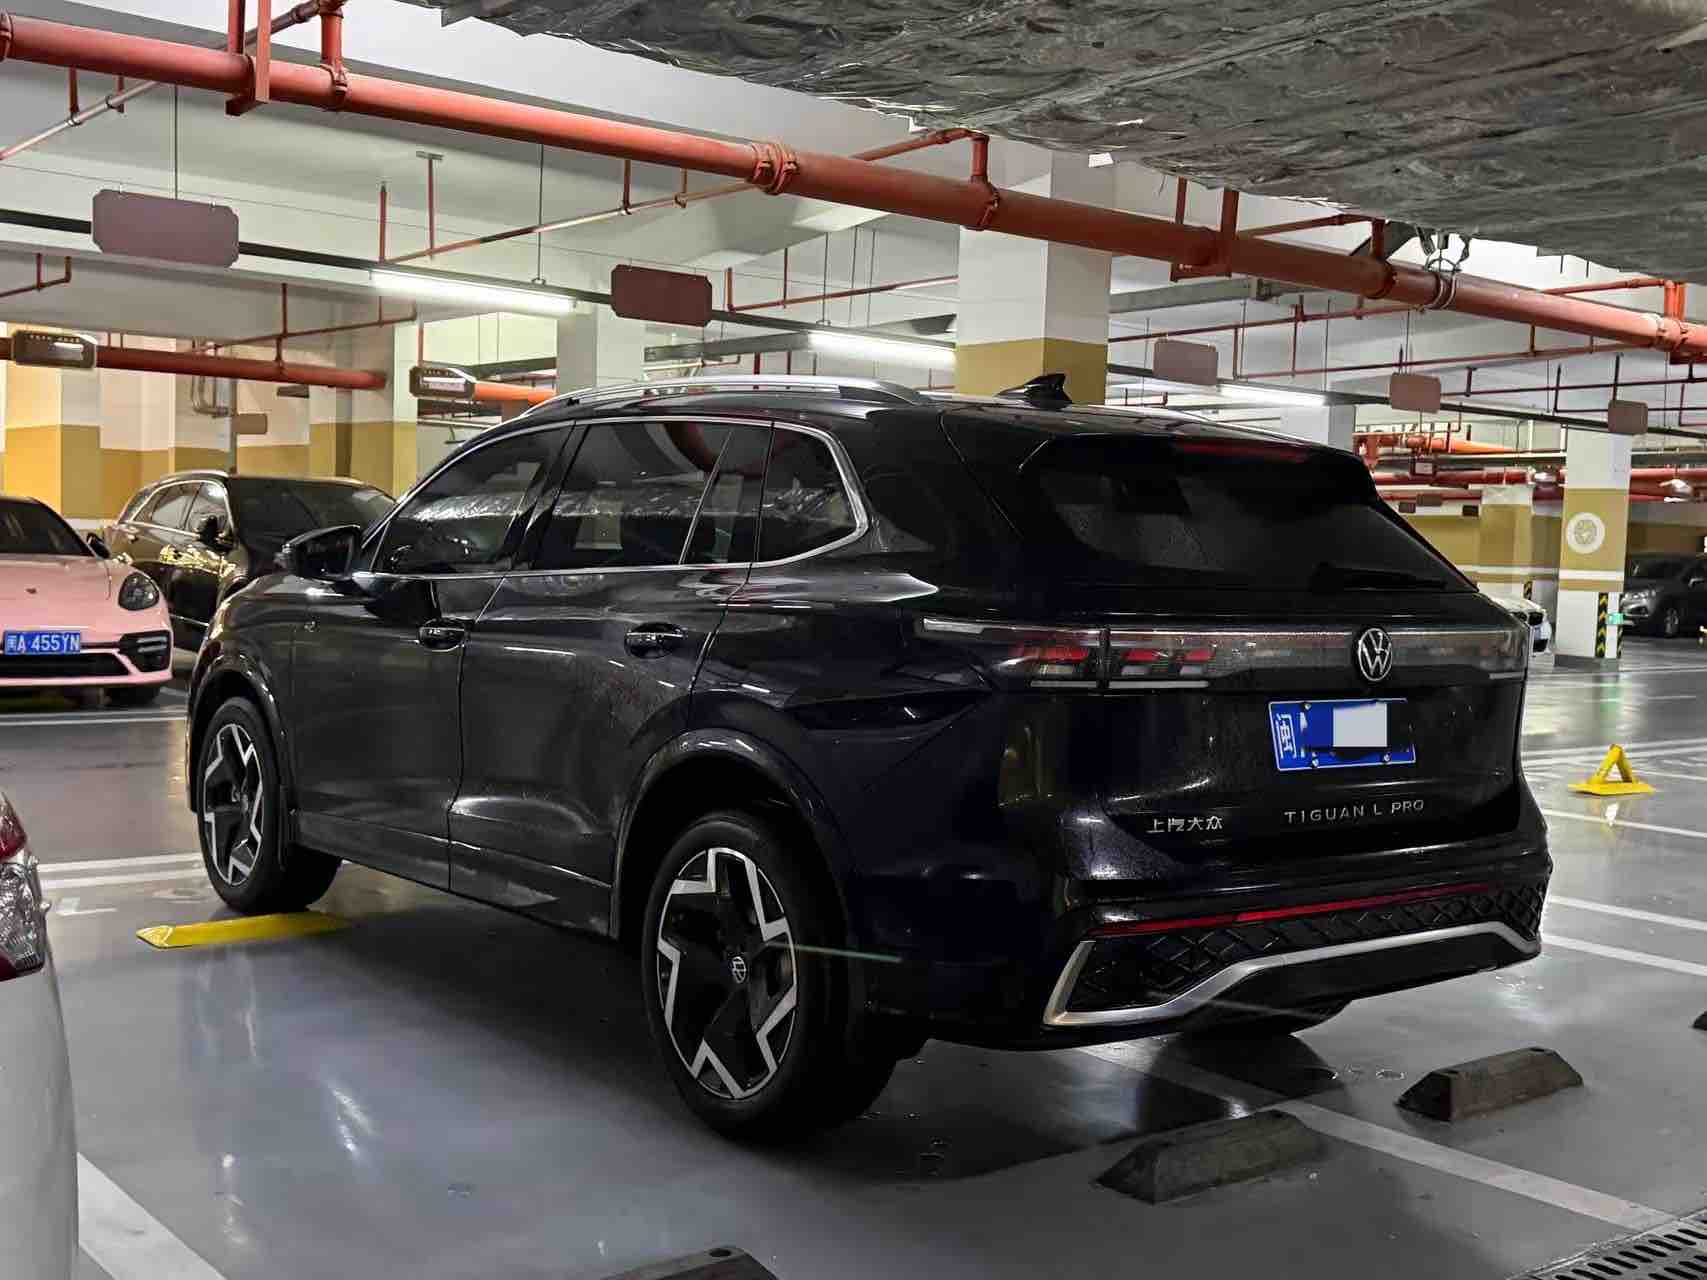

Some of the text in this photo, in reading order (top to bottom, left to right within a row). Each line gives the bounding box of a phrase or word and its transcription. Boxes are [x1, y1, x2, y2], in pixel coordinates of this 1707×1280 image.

[1284, 799, 1424, 824] TIGUAN L PRO
[1146, 815, 1223, 834] 上汽大众
